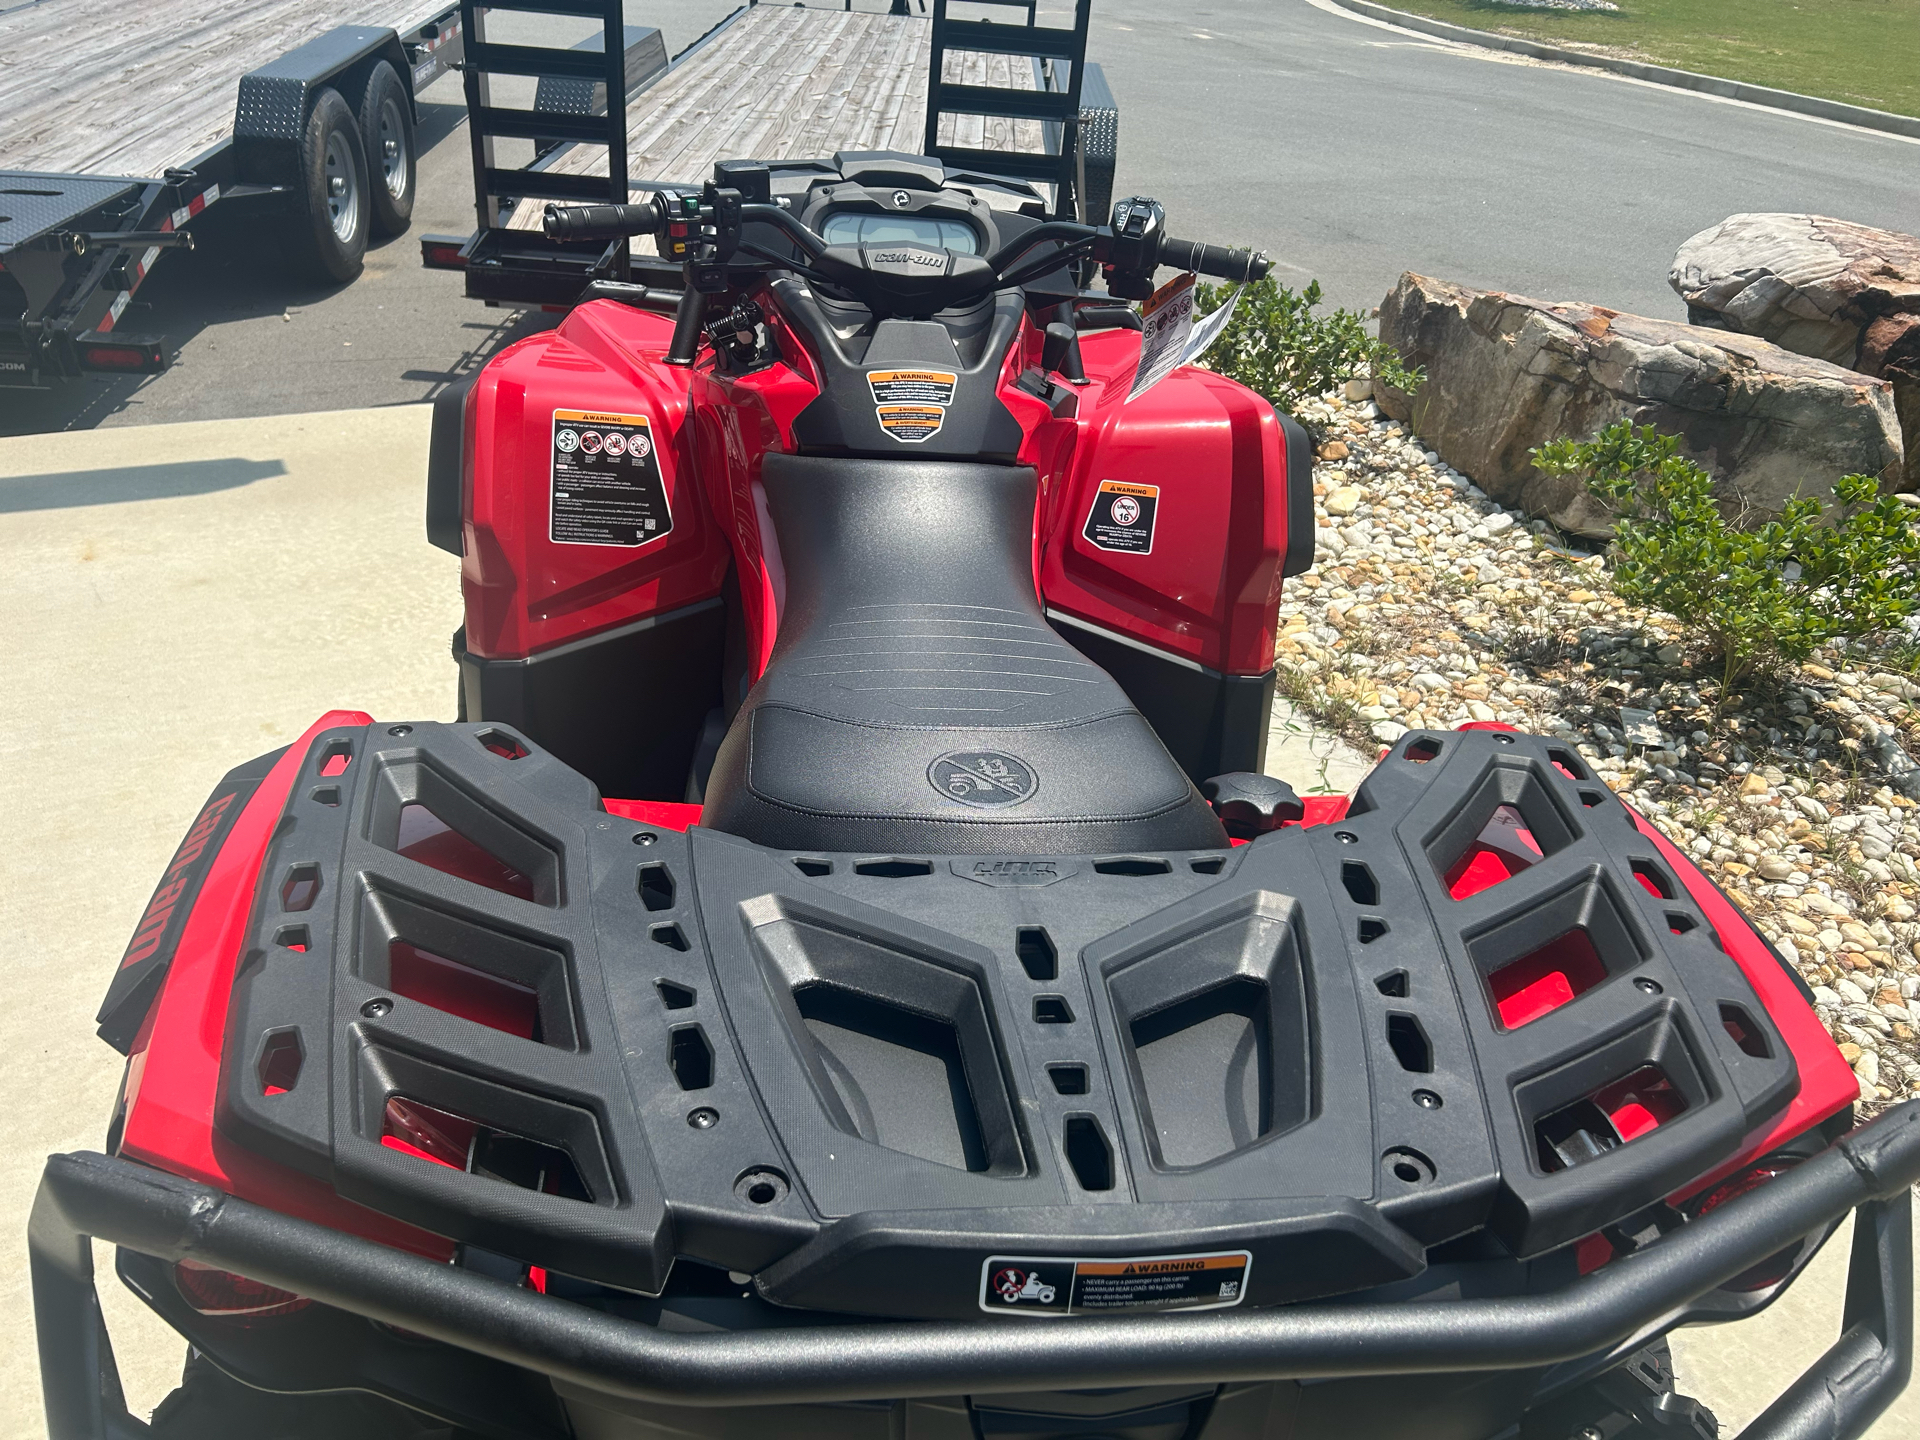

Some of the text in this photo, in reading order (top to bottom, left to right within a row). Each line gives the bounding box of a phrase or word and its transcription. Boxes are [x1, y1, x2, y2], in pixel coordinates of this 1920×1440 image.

[874, 252, 944, 268] can-am
[589, 414, 623, 423] WARNING
[1116, 487, 1147, 495] WARNING
[1119, 513, 1130, 522] 16
[121, 792, 238, 971] can-am
[1138, 1260, 1205, 1272] WARNING
[1124, 1278, 1152, 1286] passenger
